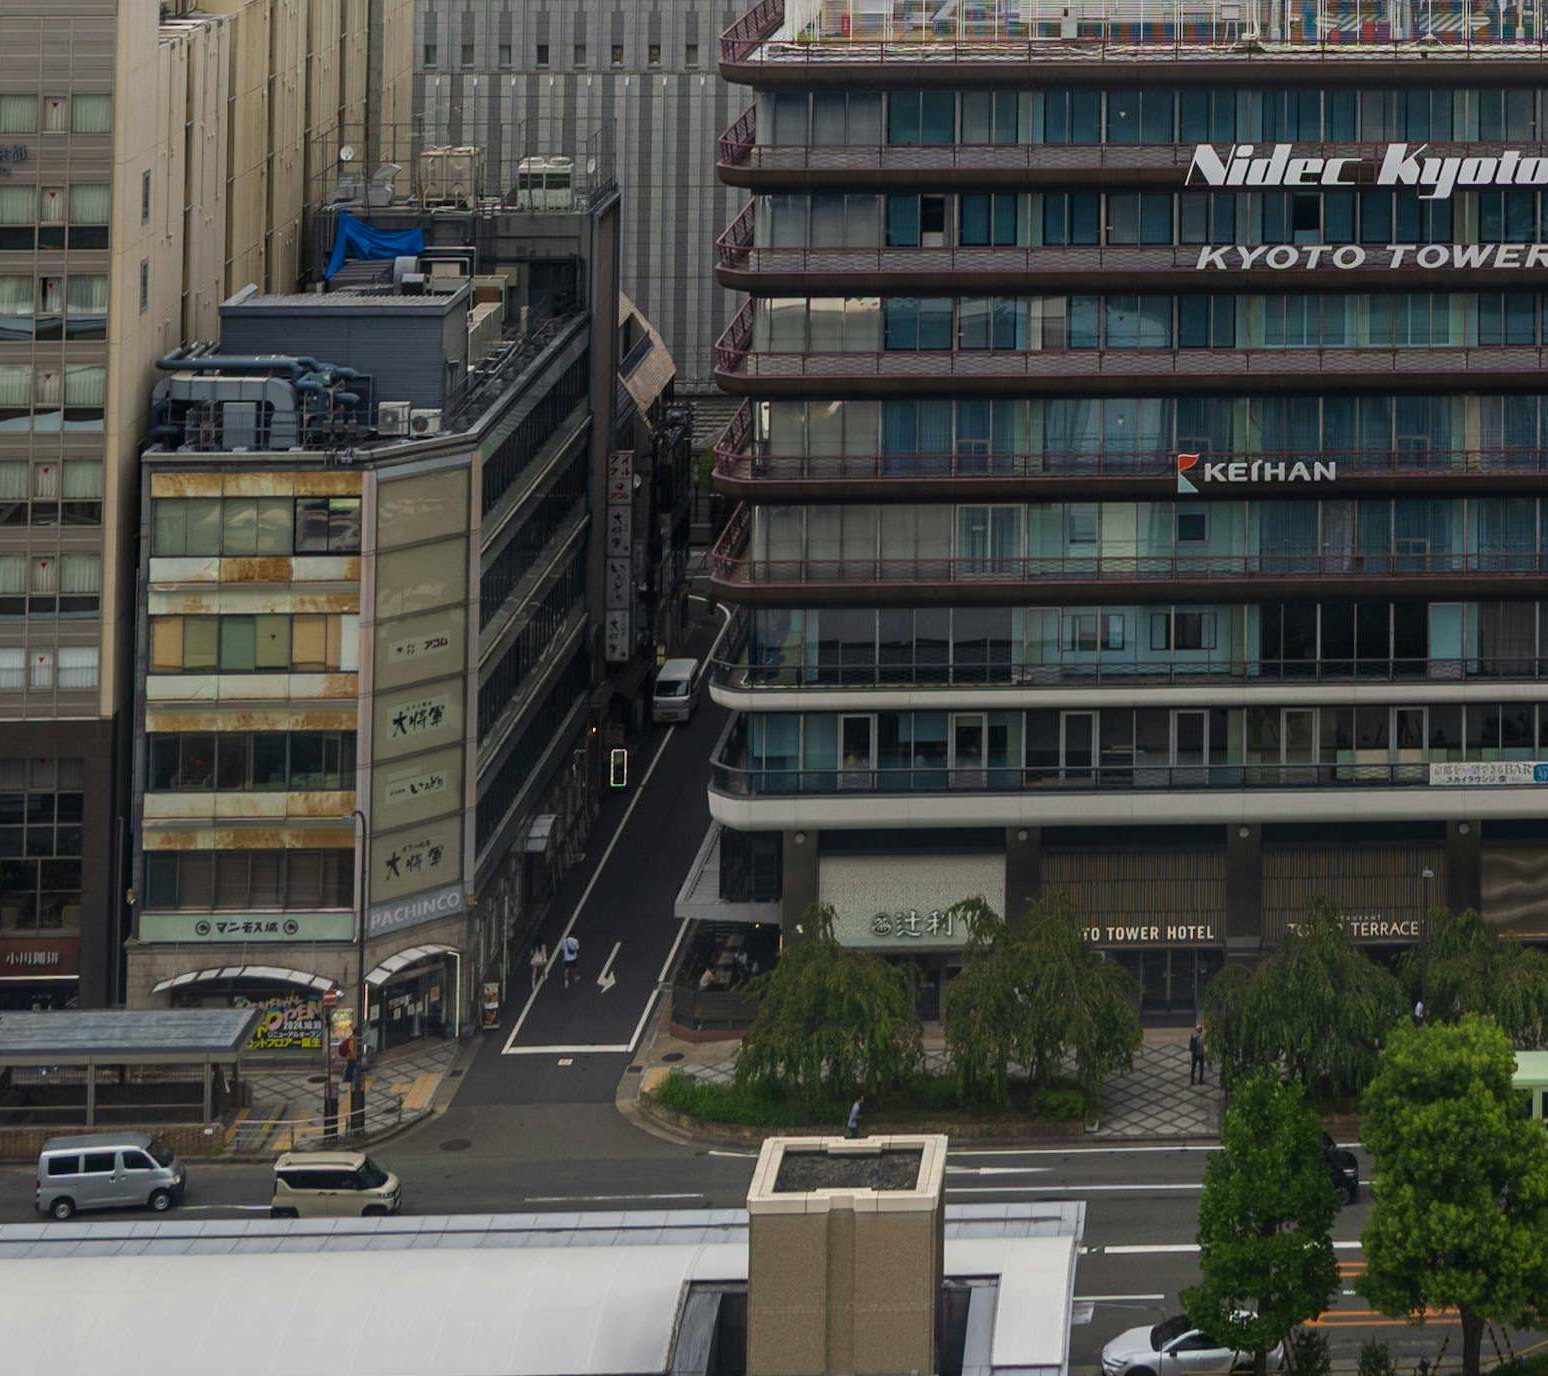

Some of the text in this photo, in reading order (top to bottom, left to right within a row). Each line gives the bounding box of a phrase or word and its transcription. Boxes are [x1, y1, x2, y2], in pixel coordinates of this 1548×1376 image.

[1185, 144, 1363, 186] Nidec
[1196, 245, 1366, 271] KYOTO
[1204, 459, 1336, 482] KEIHAN
[392, 704, 445, 738] 大将軍
[371, 892, 461, 930] PACHINCO
[1106, 927, 1159, 941] TOWER
[1167, 926, 1214, 940] HOTEL
[1350, 921, 1419, 937] TERRACE
[263, 1000, 323, 1030] OPEN
